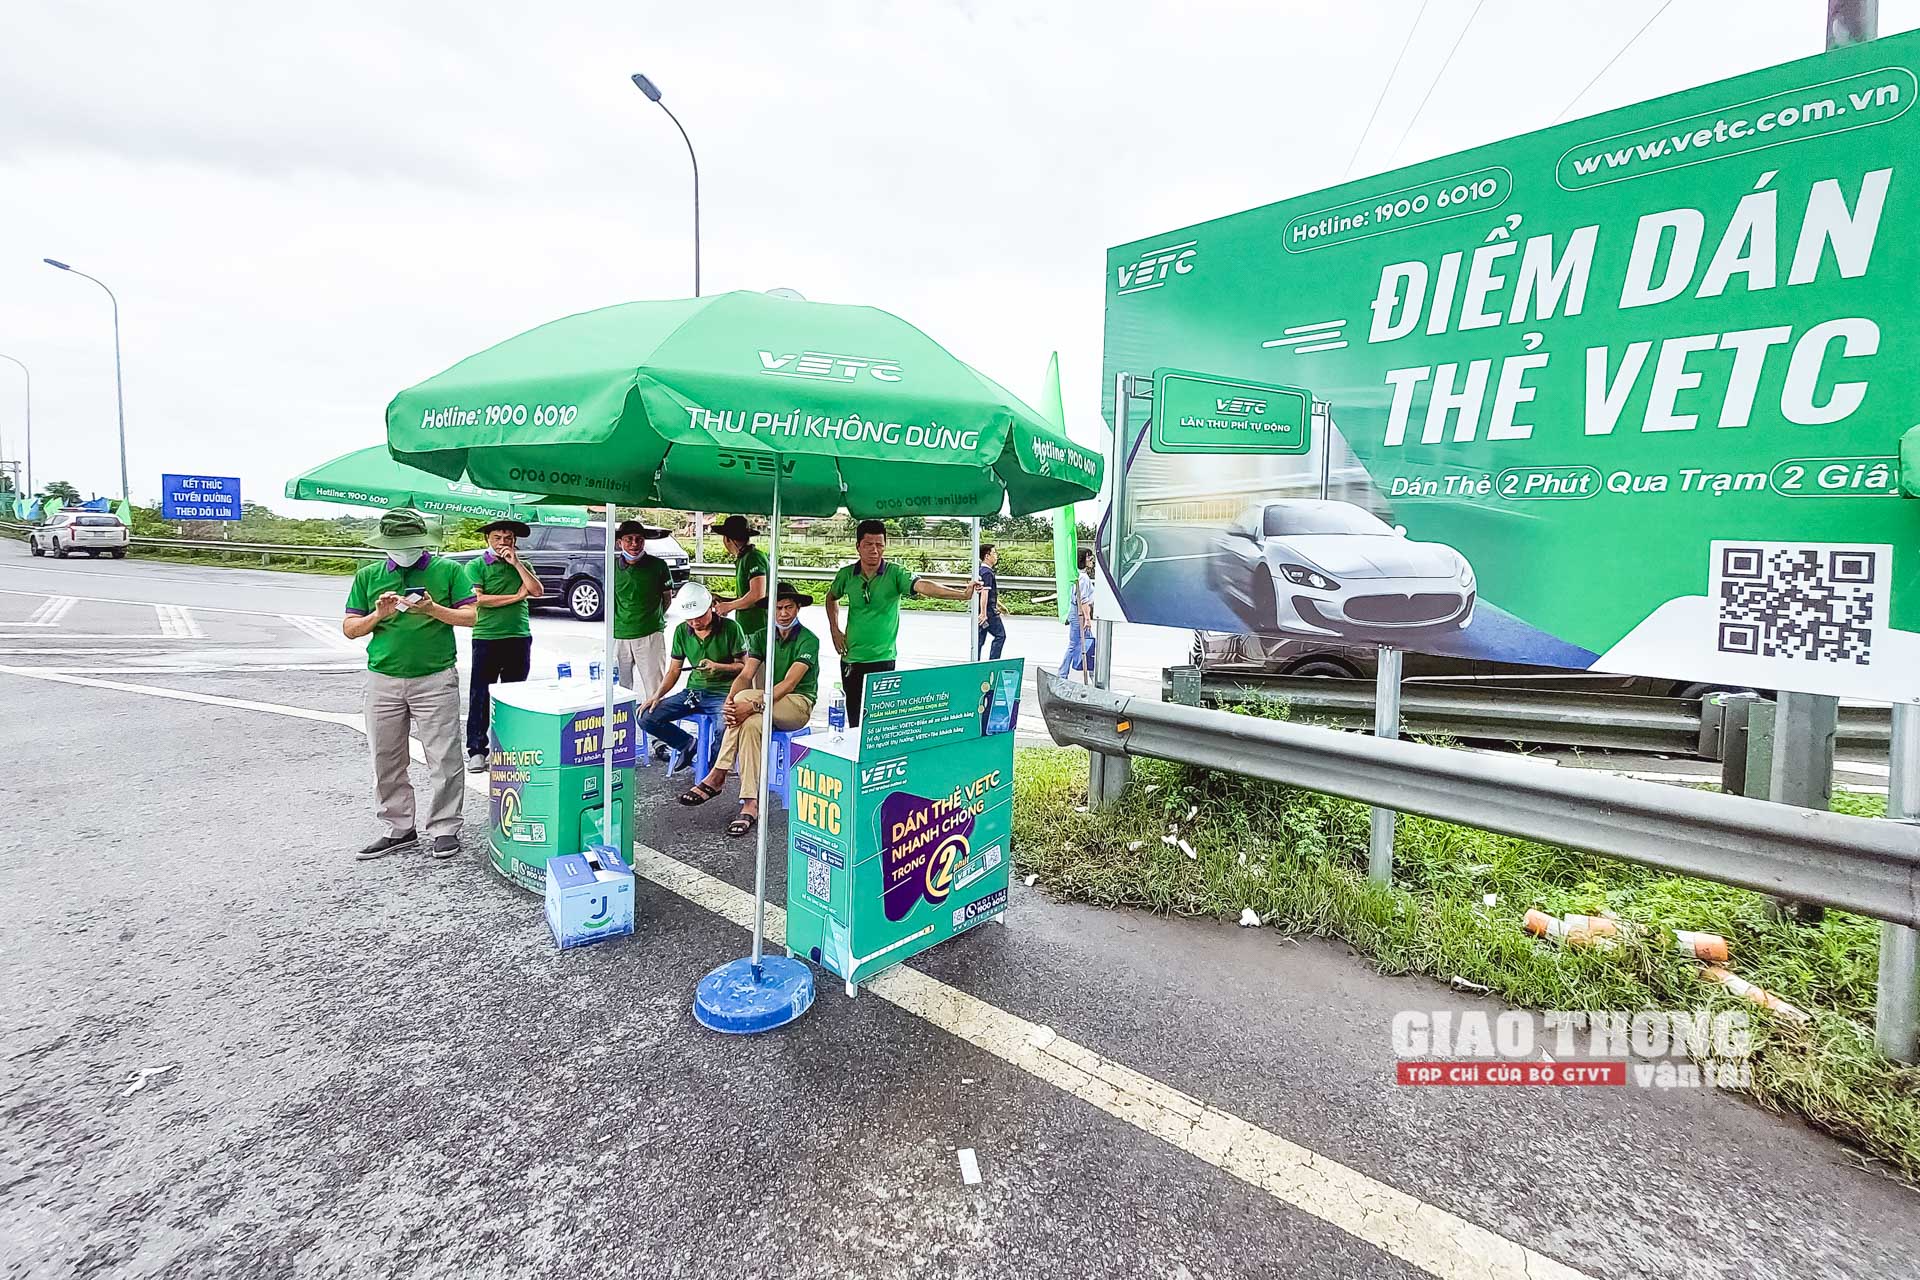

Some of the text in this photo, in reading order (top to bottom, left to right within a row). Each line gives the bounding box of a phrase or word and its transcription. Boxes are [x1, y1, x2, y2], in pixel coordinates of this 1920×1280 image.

[1572, 81, 1901, 177] www.vetc.com.vn
[1292, 178, 1498, 243] Hotline: 1900 6010
[1117, 248, 1198, 289] VETC
[1366, 167, 1894, 344] ĐIỂM DÁN
[757, 351, 904, 383] VETC
[1383, 317, 1881, 447] THẺ VETC
[421, 404, 578, 429] Hotline: 1900 6010
[1217, 398, 1267, 414] VETC
[684, 406, 979, 450] THU PHÍ KHÔNG DỪNG
[1180, 416, 1291, 433] LÀN THU PHÍ TỰ ĐỘNG
[316, 487, 389, 505] Hotline: 1900 6010
[1390, 475, 1440, 497] Dán
[1442, 473, 1492, 495] Thẻ
[1502, 475, 1519, 494] 2
[1522, 471, 1592, 495] Phút
[1605, 472, 1668, 494] Qua
[1678, 468, 1768, 498] Trạm
[1780, 464, 1803, 489] 2
[175, 506, 198, 516] THEO
[424, 501, 444, 511] THU
[445, 502, 462, 512] PHÍ
[463, 504, 497, 517] KHÔNG
[872, 678, 902, 691] VETC
[870, 700, 896, 711] THÔNG
[896, 698, 908, 707] TIN
[502, 746, 517, 766] THẺ
[517, 749, 544, 767] VETC
[574, 732, 598, 756] TẢI
[506, 767, 531, 783] CHÓNG
[796, 762, 817, 793] TẢI
[818, 774, 843, 801] APP
[861, 761, 908, 785] VETC
[504, 795, 514, 827] 2
[796, 789, 841, 836] VETC
[891, 809, 929, 844] DÁN
[931, 785, 964, 820] THẺ
[964, 769, 1001, 800] VETC
[891, 799, 985, 864] NHANH CHÓNG
[891, 853, 926, 882] TRONG
[935, 843, 958, 890] 2
[976, 889, 1007, 907] HOTLINE
